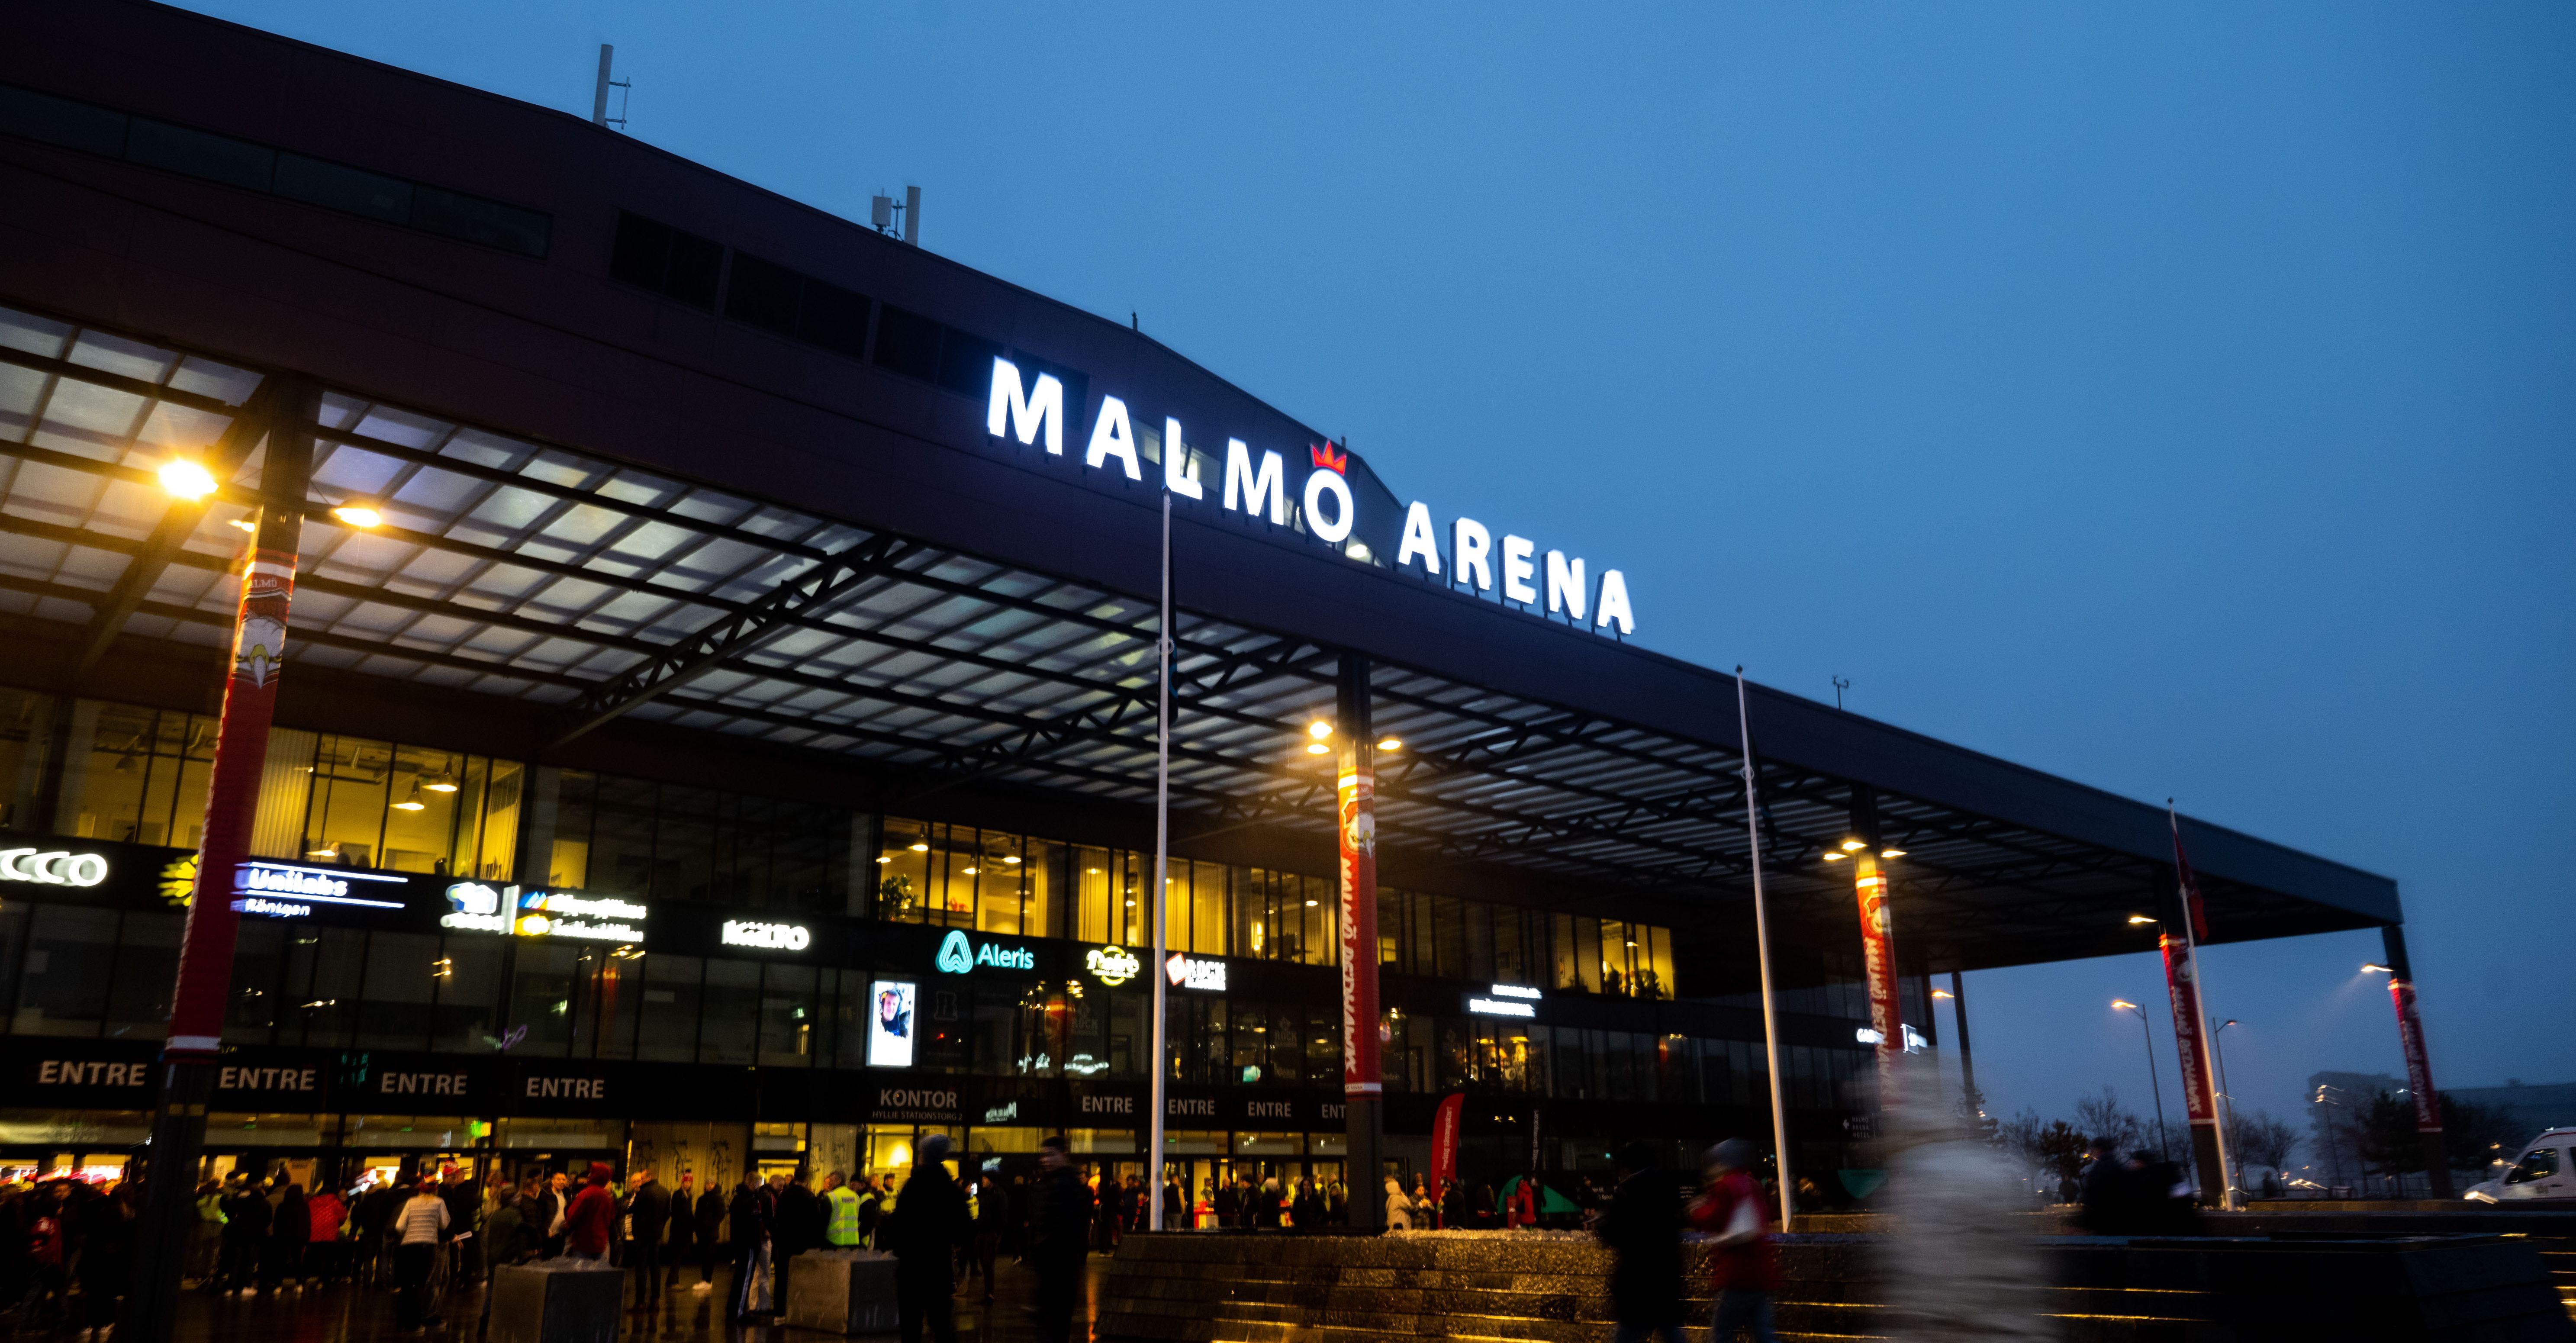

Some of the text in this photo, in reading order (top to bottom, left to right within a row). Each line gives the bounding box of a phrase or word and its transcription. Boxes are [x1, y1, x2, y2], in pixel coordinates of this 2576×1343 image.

[1397, 500, 1634, 634] ARENA
[246, 578, 277, 589] ALMÖ
[248, 868, 348, 896] Unilabs
[245, 898, 311, 917] Röntgen
[976, 943, 1034, 969] Aleris
[1185, 959, 1226, 980] ROCK
[880, 1088, 957, 1109] KONTOR
[873, 1110, 963, 1121] HYLLIE STATIONSTORG 2
[1321, 1103, 1346, 1119] ENT
